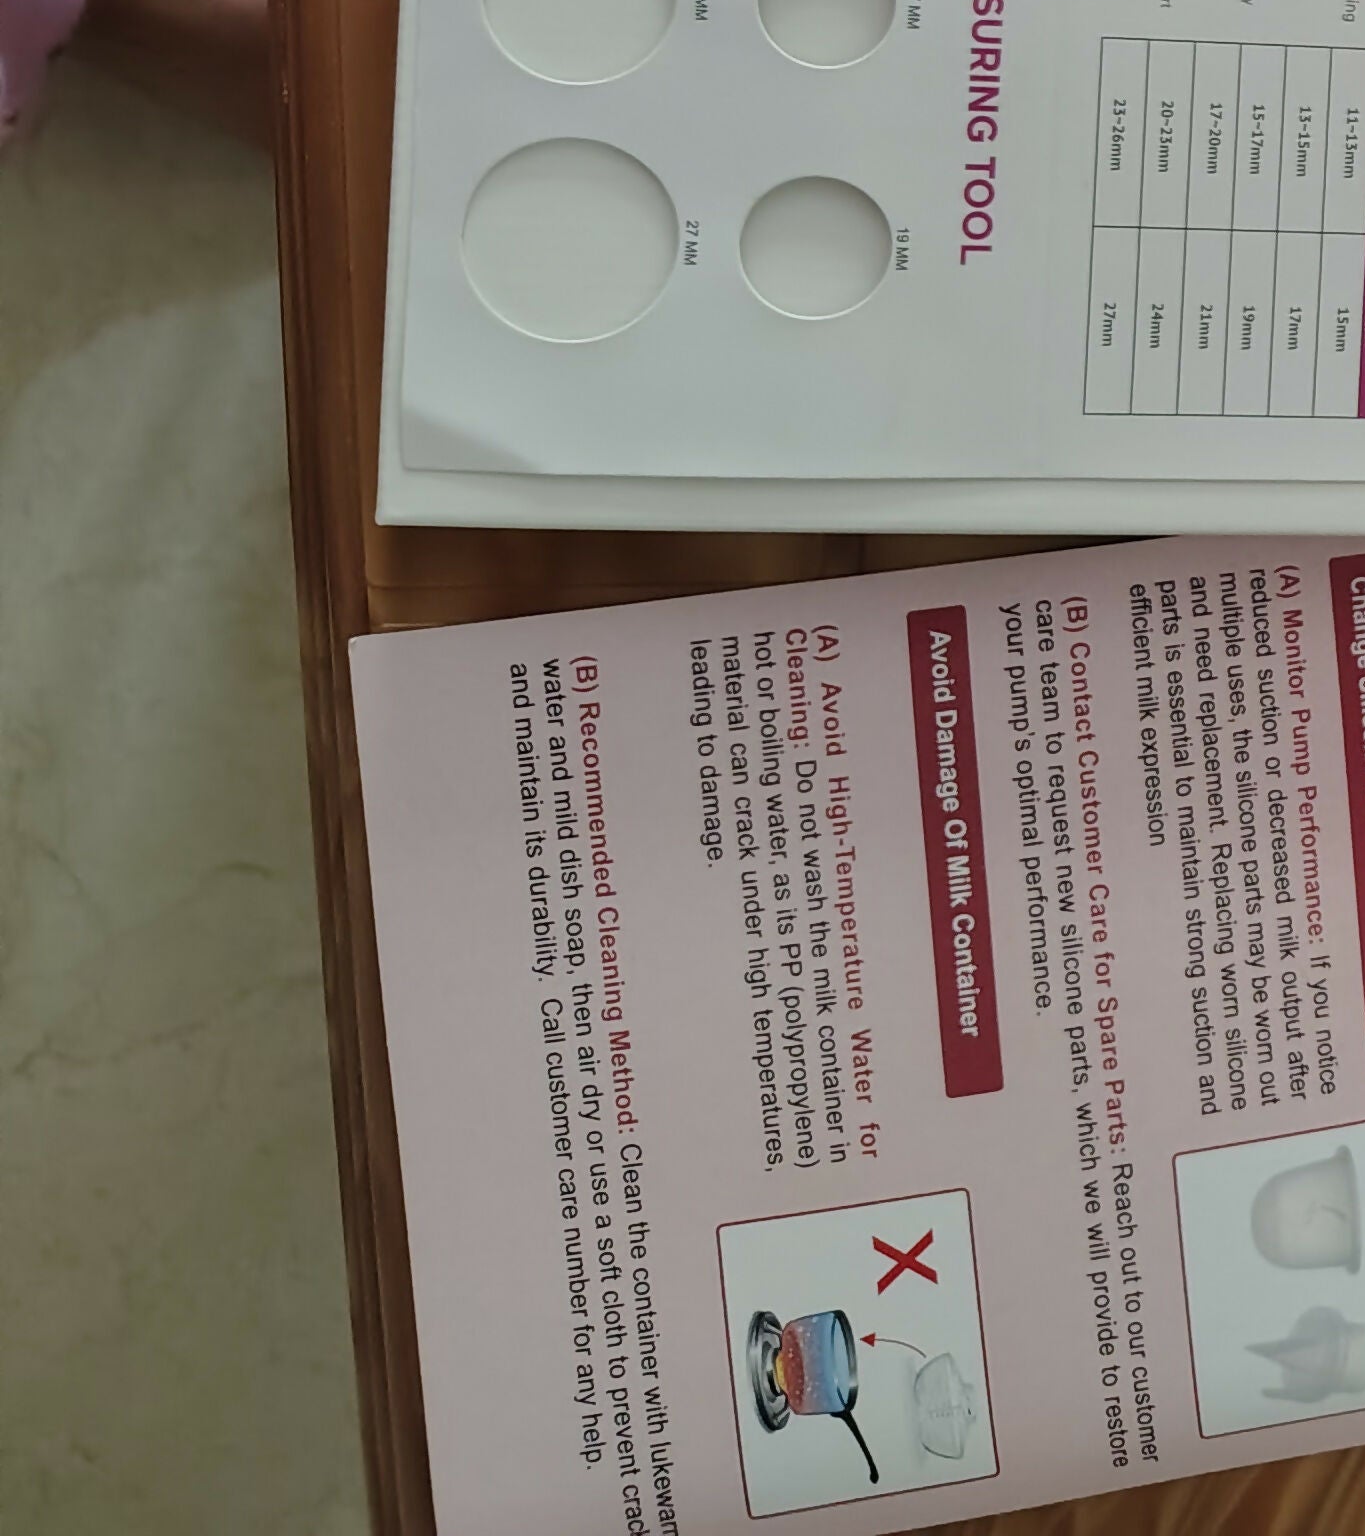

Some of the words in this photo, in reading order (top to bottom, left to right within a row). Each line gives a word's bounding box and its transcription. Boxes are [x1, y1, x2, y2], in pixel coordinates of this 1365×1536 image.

[906, 4, 921, 29] MM
[685, 219, 699, 236] 27
[959, 155, 996, 265] TOOL
[683, 240, 698, 265] MM
[895, 227, 909, 243] 19
[895, 246, 909, 271] MM
[1101, 302, 1117, 346] 27mm
[1149, 303, 1164, 348] 24mm
[1197, 303, 1213, 349] 21mm
[1240, 305, 1255, 350] 19mm
[1287, 306, 1302, 350] 17mm
[1334, 307, 1350, 352] 15mm
[1272, 564, 1301, 599] (A)
[929, 630, 956, 703] Avoid
[1281, 608, 1307, 698] Monitor
[934, 709, 959, 812] Damage
[1289, 708, 1311, 775] Pump
[943, 818, 968, 849] Of
[946, 854, 972, 908] Milk
[1297, 785, 1323, 944] Performance:
[951, 913, 980, 1037] Container
[1309, 954, 1331, 968] If
[1306, 977, 1329, 1018] you
[1315, 1029, 1338, 1094] notice
